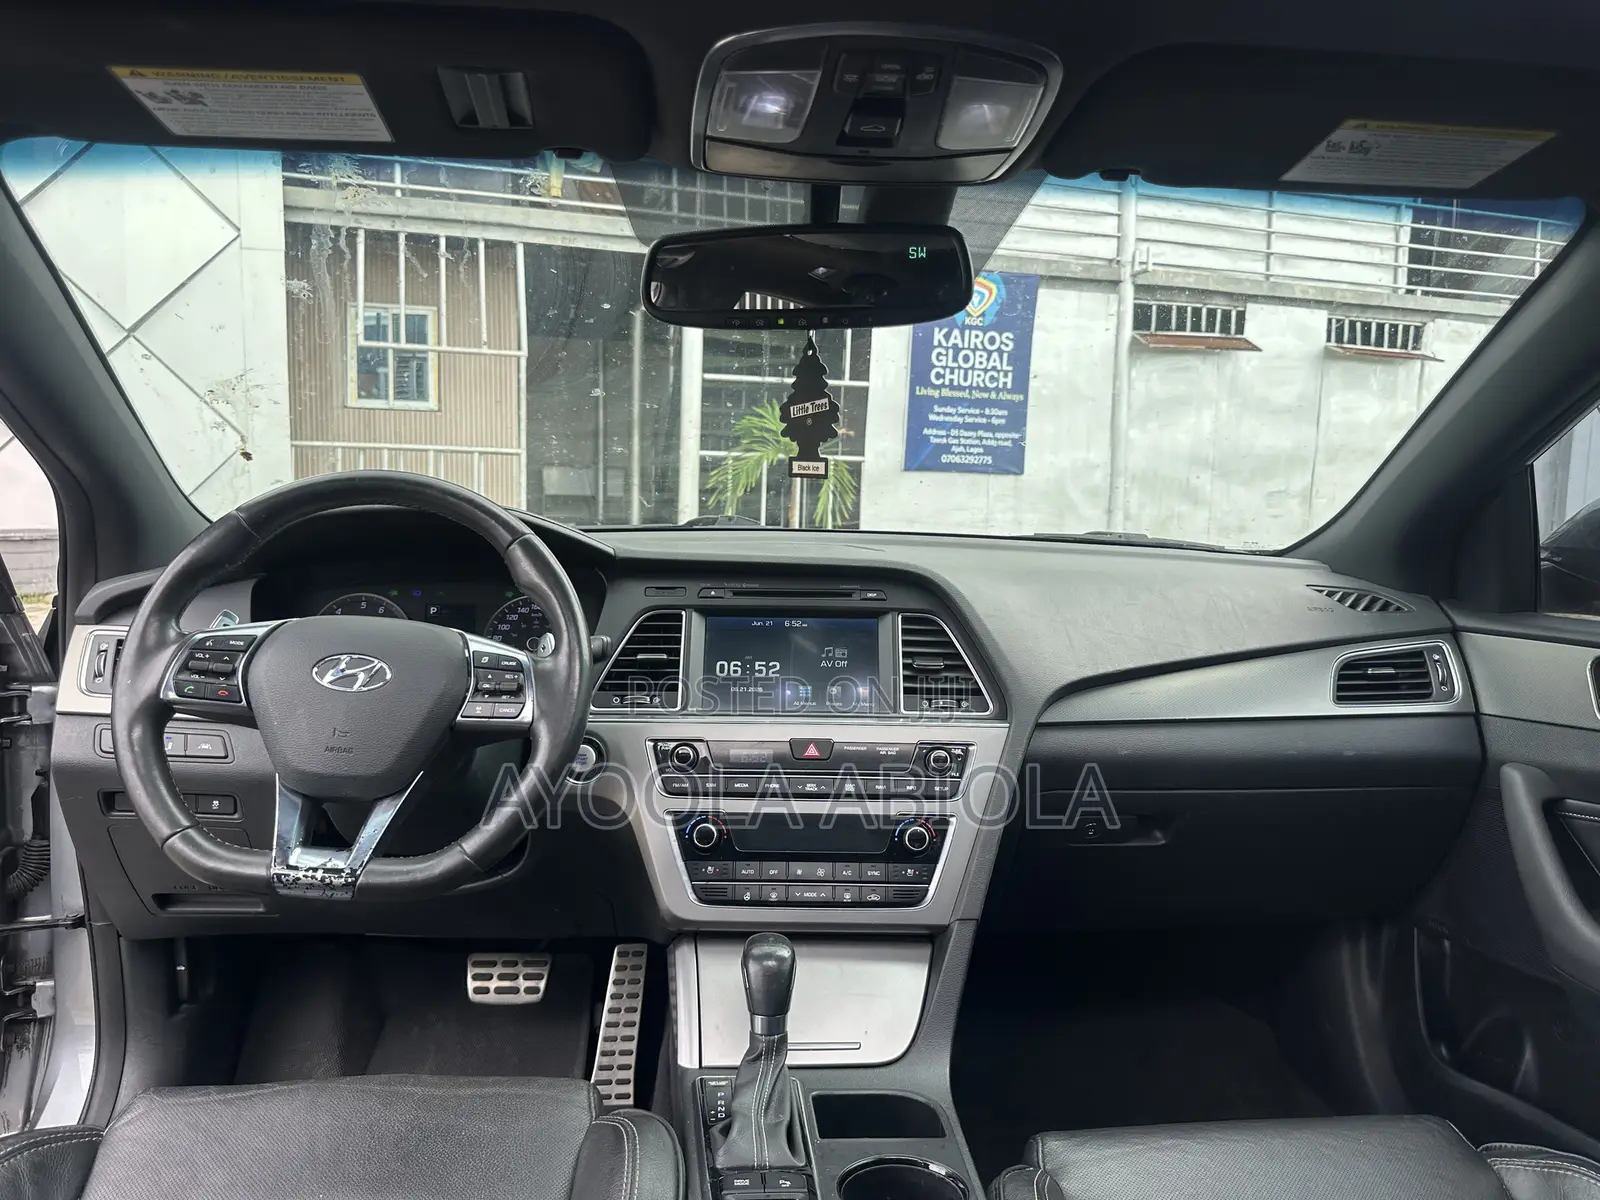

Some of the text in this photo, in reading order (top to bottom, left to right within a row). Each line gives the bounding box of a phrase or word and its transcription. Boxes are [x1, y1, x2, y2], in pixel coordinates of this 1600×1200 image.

[909, 246, 926, 259] SW
[964, 316, 984, 326] KGC
[932, 326, 1014, 352] KAIROS
[931, 348, 1013, 370] GLOBAL
[930, 367, 1012, 389] CHURCH
[916, 386, 940, 398] Living
[998, 391, 1024, 402] Always
[792, 401, 828, 416] Little Trees
[933, 404, 957, 414] Sunday
[957, 406, 980, 414] Service
[928, 414, 964, 424] Wednesday
[964, 415, 987, 424] Service
[940, 454, 992, 465] 07063292775
[430, 606, 438, 614] P
[324, 746, 354, 754] AIRBAG
